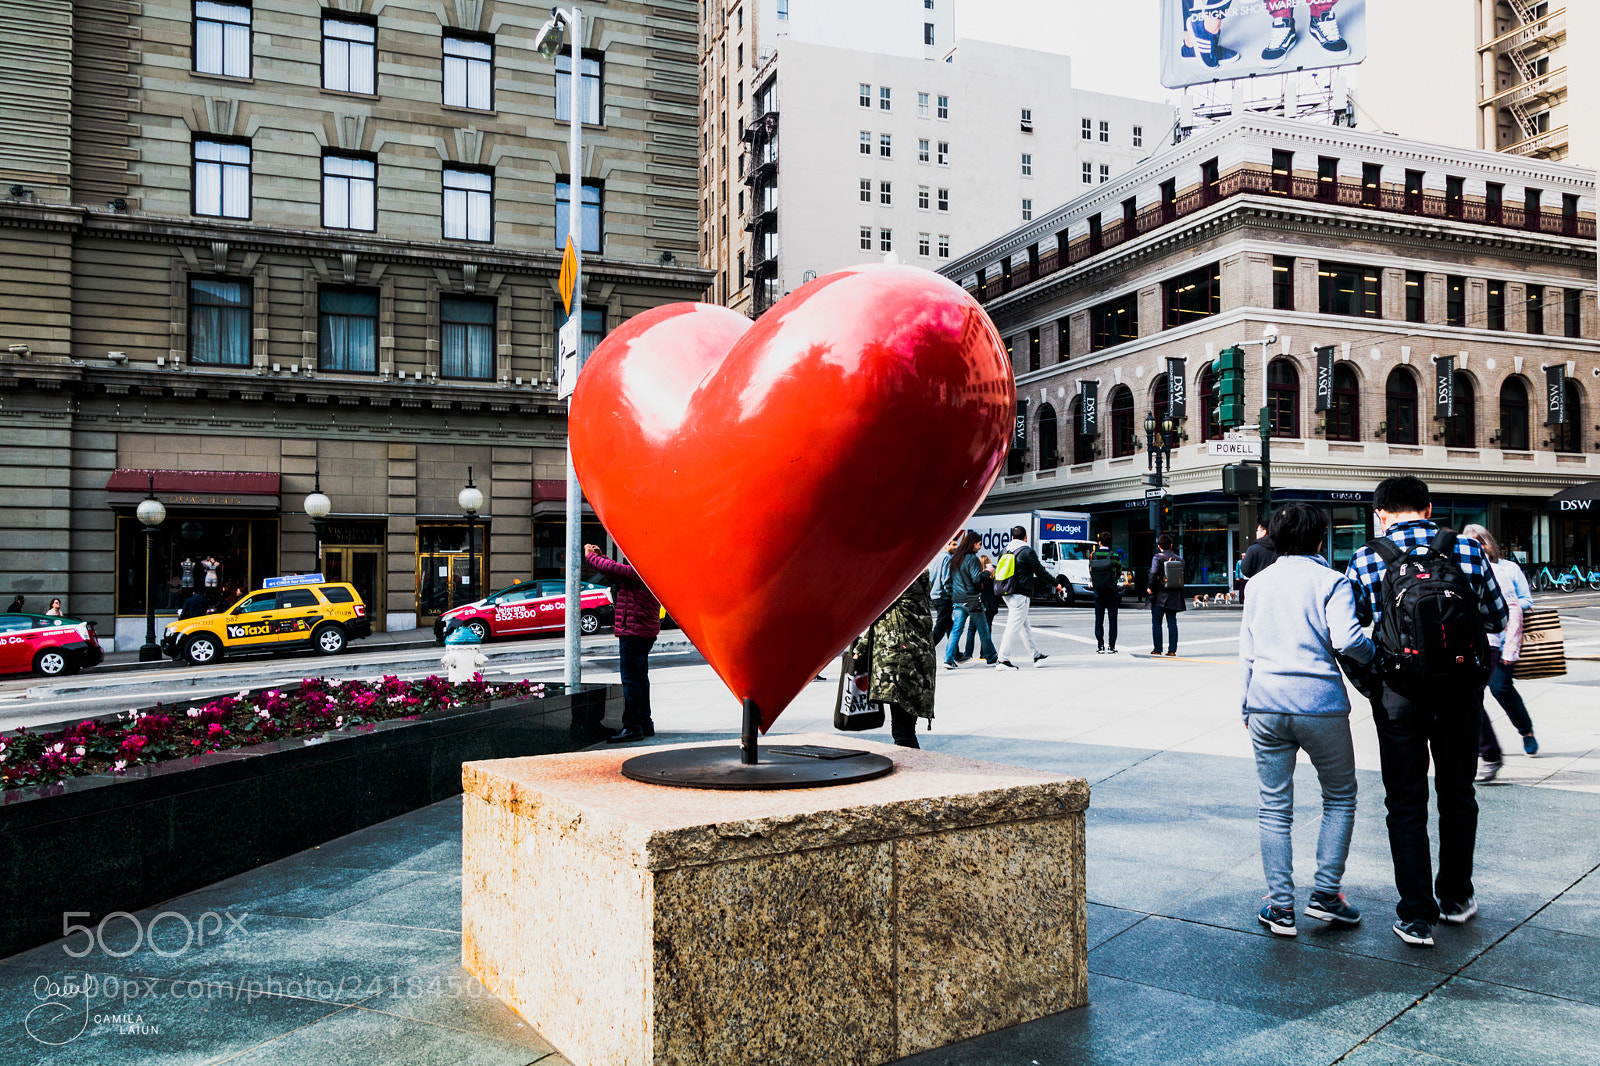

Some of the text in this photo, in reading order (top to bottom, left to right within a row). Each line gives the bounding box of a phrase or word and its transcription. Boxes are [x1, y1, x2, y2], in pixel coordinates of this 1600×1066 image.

[1191, 7, 1238, 23] DESIGNER
[1240, 4, 1268, 15] SHOE
[1319, 366, 1328, 396] DSW
[1173, 375, 1183, 405] DSW
[1438, 375, 1448, 404] DSW
[1549, 383, 1560, 411] DSW
[1086, 397, 1095, 424] DSW
[1016, 415, 1025, 439] DSW
[1216, 443, 1253, 454] POWELL
[1331, 492, 1355, 500] CHASE
[1560, 500, 1591, 510] DSW
[1056, 523, 1081, 535] Budget
[495, 606, 526, 615] Veterans
[539, 603, 554, 612] Cab
[495, 609, 536, 621] 552-1300
[228, 621, 270, 637] YoTaxi
[9, 636, 24, 644] Co.
[845, 676, 853, 695] I
[845, 694, 867, 704] CAP
